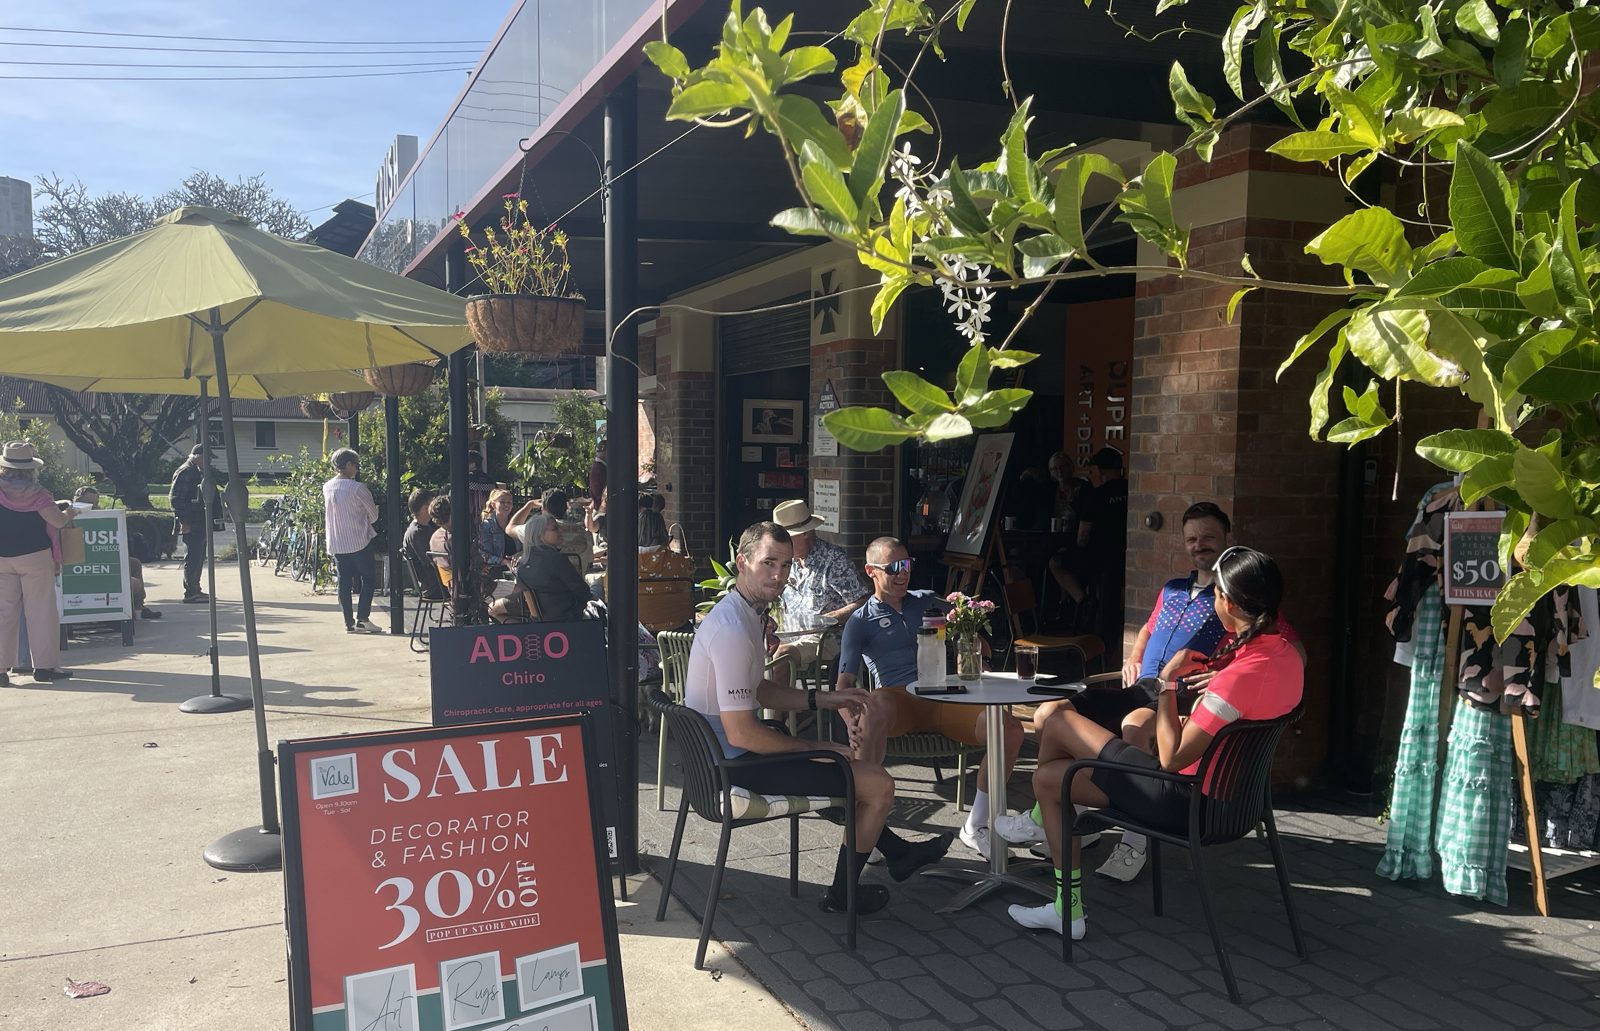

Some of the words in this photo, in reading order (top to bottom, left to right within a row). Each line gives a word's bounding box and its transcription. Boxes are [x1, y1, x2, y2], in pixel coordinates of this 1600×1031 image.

[1078, 365, 1095, 409] ART
[819, 401, 835, 409] ACTION
[84, 530, 120, 545] USH
[72, 565, 110, 574] OPEN
[1453, 559, 1500, 586] $50
[1454, 589, 1475, 598] THIS
[502, 671, 545, 686] Chiro
[443, 706, 493, 717] Chiropractic
[515, 702, 561, 713] appropriate
[562, 701, 574, 709] for
[575, 699, 585, 707] all
[585, 699, 603, 708] ages
[321, 765, 350, 787] Vale
[381, 733, 568, 803] SALE
[316, 803, 334, 811] Open
[370, 810, 529, 845] DECORATOR
[371, 850, 387, 868] &
[403, 831, 529, 865] FASHION
[516, 860, 539, 907] OFF
[374, 862, 516, 950] 30%
[429, 930, 451, 940] POP
[455, 927, 468, 937] UP
[472, 921, 507, 934] STORE
[510, 916, 538, 928] WIDE
[531, 956, 572, 992] Lamps
[361, 974, 414, 1031] Art
[446, 960, 500, 1021] Rugs
